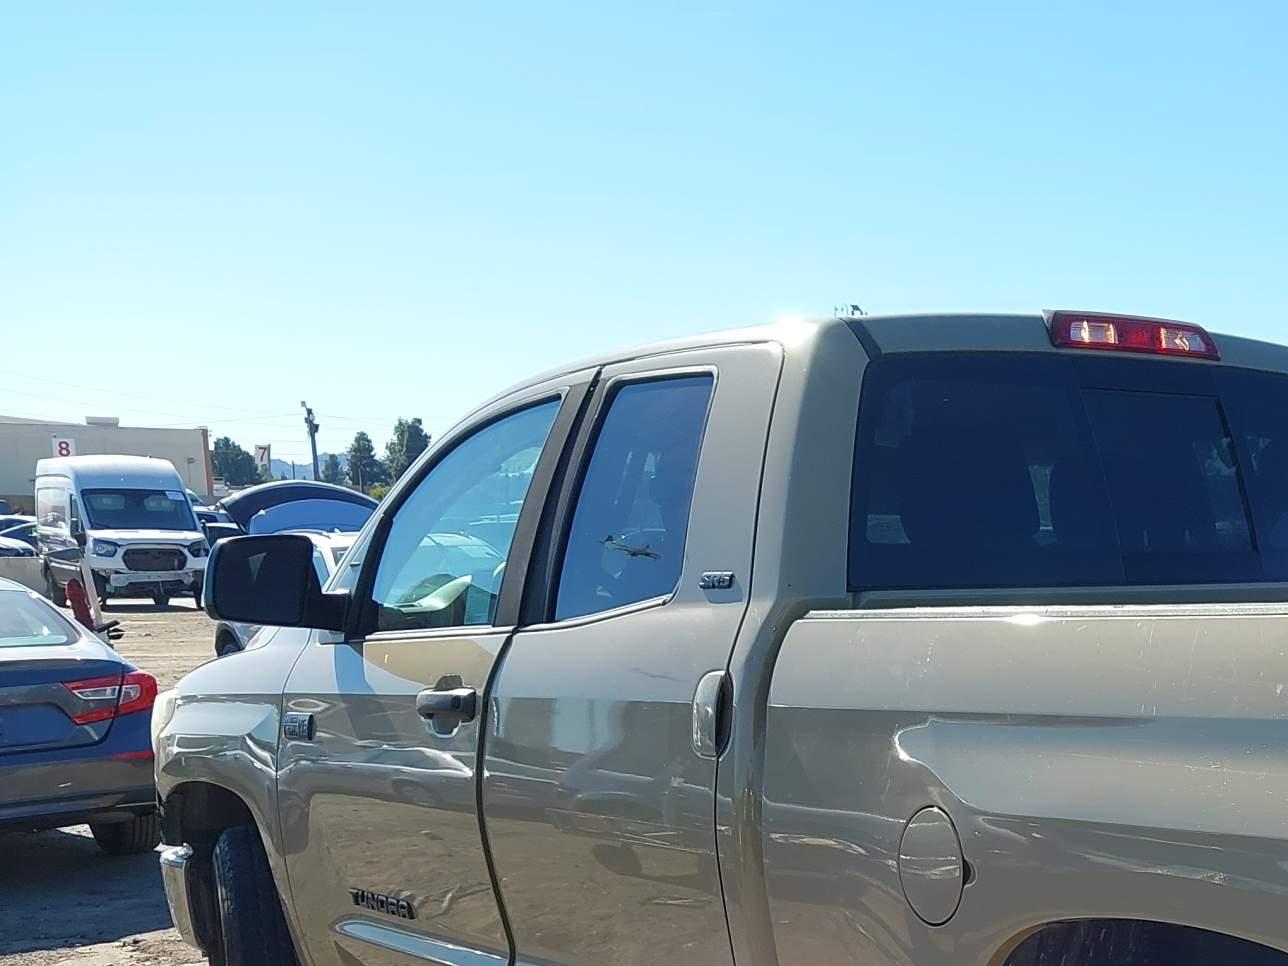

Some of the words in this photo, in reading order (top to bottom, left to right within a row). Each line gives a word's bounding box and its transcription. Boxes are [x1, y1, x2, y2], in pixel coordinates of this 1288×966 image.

[58, 441, 71, 457] 8
[257, 446, 267, 463] 7
[348, 888, 416, 920] TUNDRA
